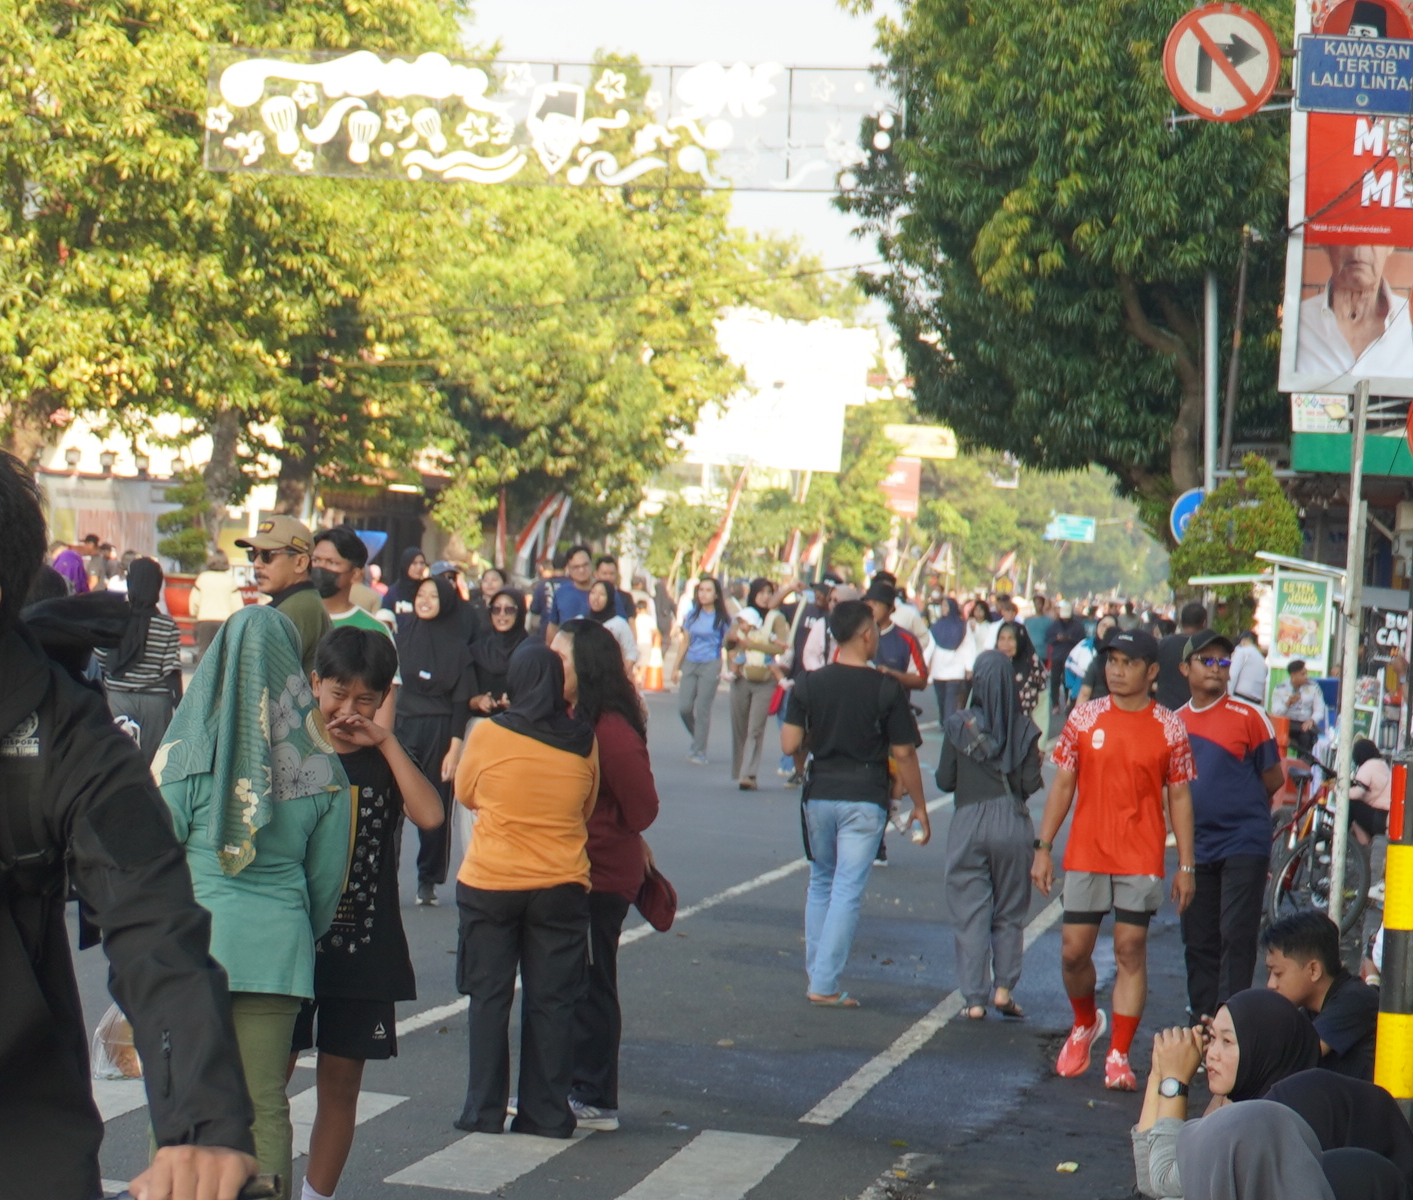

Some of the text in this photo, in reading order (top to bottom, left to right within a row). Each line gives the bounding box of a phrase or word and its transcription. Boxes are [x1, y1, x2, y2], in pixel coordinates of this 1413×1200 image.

[1324, 41, 1410, 60] KAWASAN
[1336, 57, 1397, 75] TERTIB
[1311, 71, 1356, 88] LALU
[2, 738, 39, 746] DISPORA
